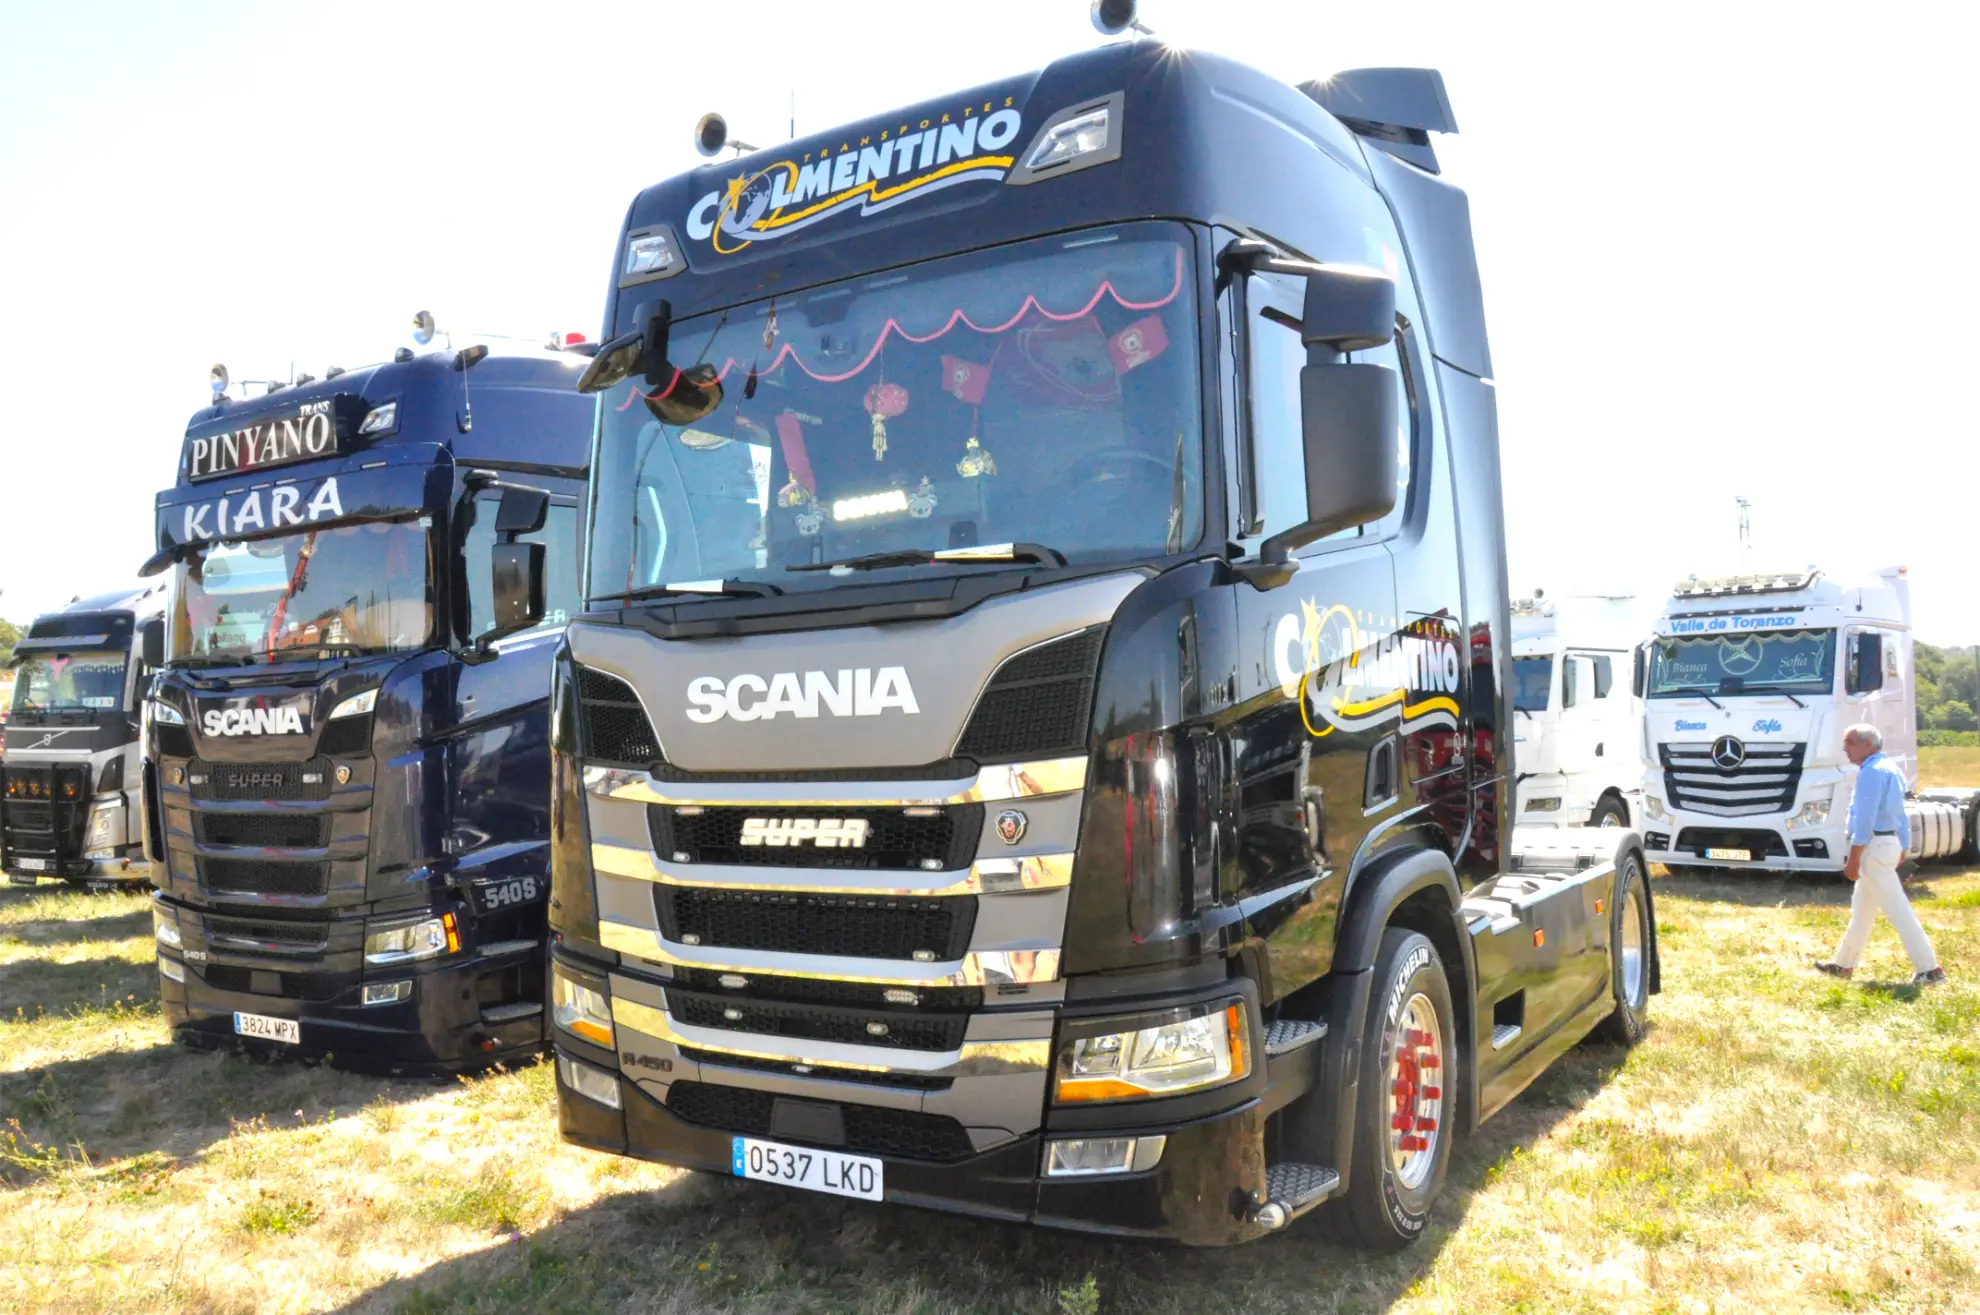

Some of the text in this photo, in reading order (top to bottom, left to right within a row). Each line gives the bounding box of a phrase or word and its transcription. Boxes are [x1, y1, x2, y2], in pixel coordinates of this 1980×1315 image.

[804, 97, 1014, 163] TRANSPORTES
[686, 109, 1021, 240] COLMENTINO
[300, 400, 330, 417] TRANS
[190, 413, 330, 477] PINYANO
[183, 477, 344, 543] KIARA
[1671, 615, 1796, 632] Valle de Toranzo
[686, 666, 920, 723] SCANIA
[203, 707, 304, 737] SCANIA
[228, 774, 286, 788] SUPER
[740, 818, 869, 848] SUPER
[1388, 947, 1429, 1026] MICHELIN
[242, 1016, 297, 1040] 3824 MPX
[750, 1146, 875, 1193] 0537 LKD
